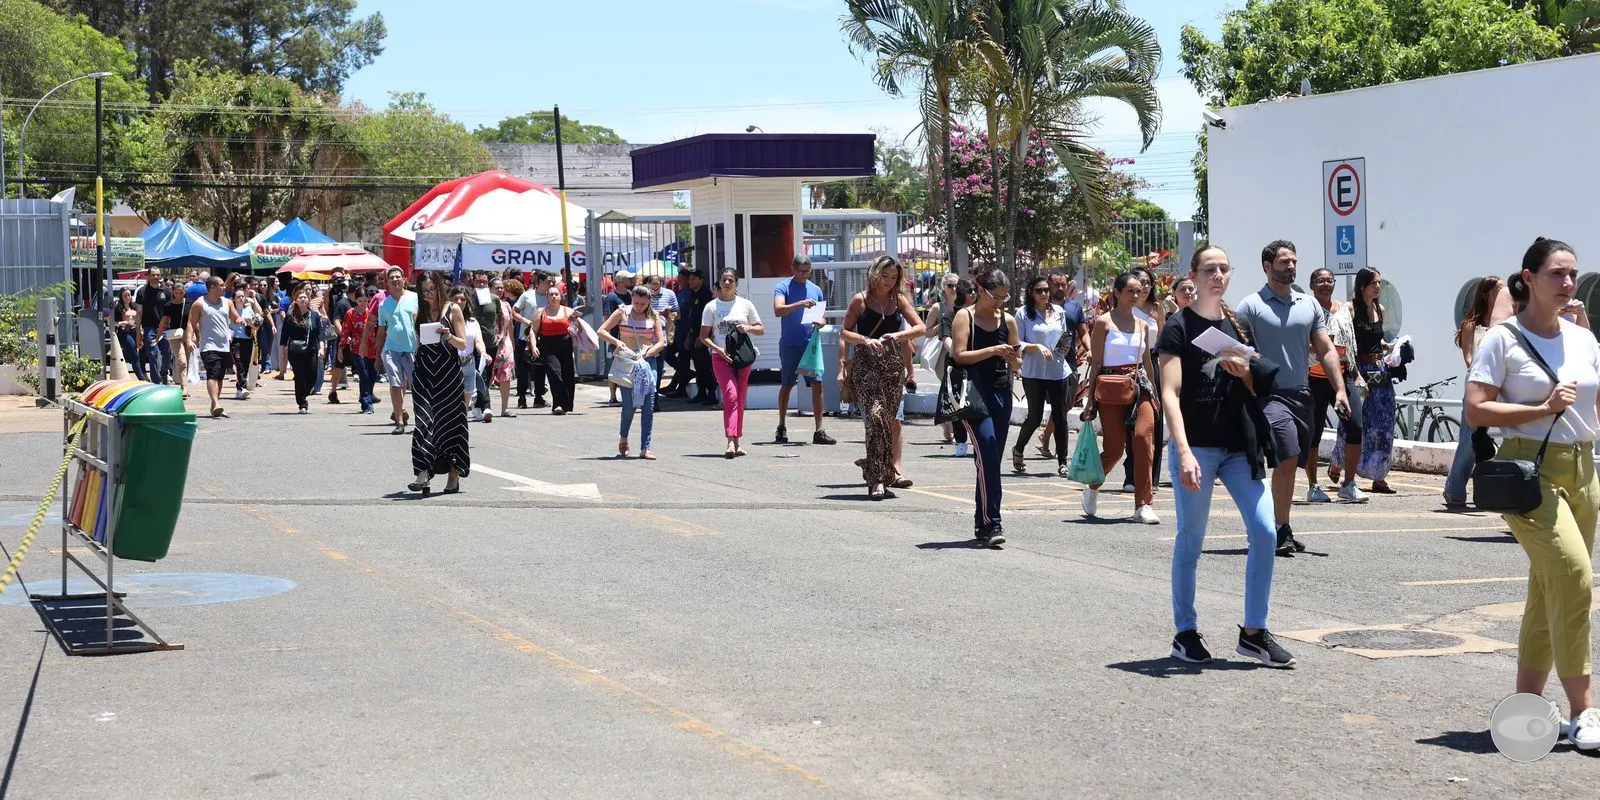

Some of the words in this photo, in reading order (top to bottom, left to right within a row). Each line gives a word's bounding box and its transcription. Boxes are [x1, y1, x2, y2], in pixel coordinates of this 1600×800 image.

[1337, 176, 1352, 207] E
[491, 249, 551, 266] GRAN
[571, 250, 631, 267] GAN
